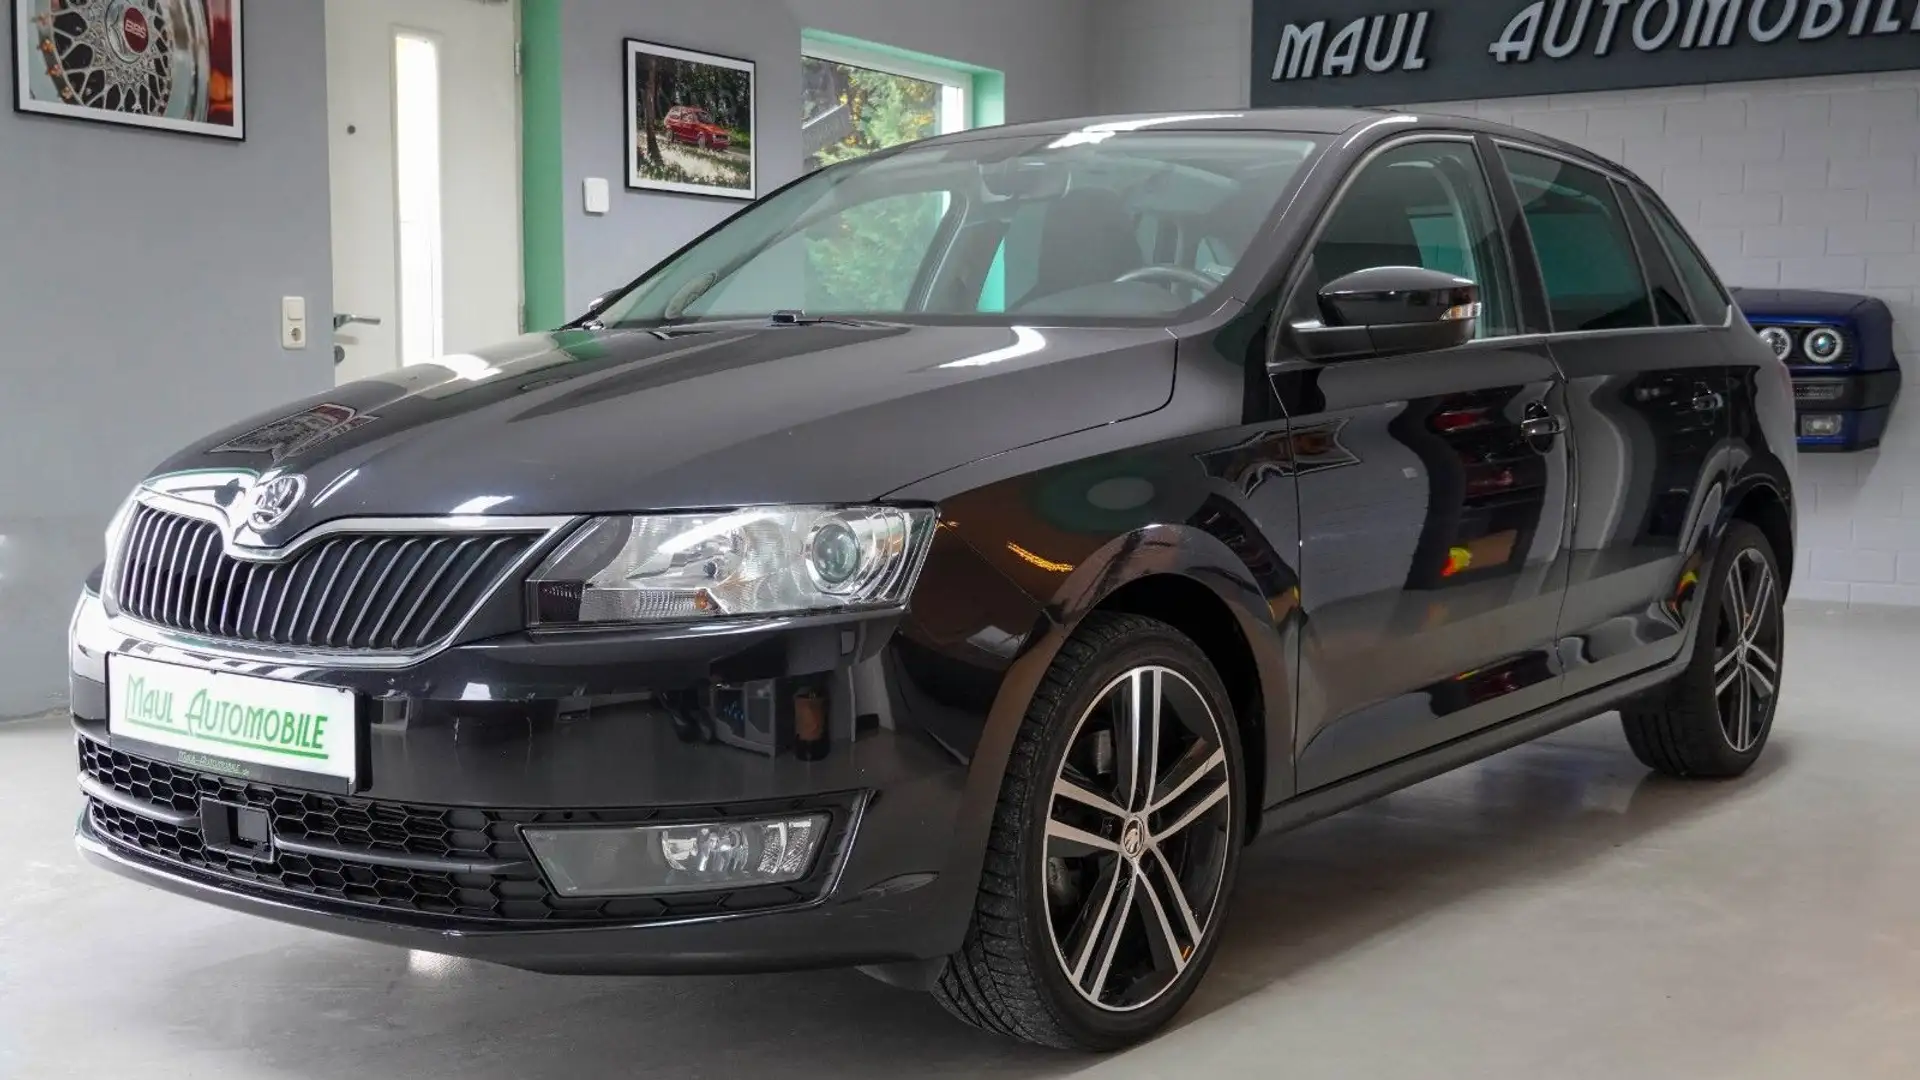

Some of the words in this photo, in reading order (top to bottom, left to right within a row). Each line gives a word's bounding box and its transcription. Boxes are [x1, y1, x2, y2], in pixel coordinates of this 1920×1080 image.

[125, 19, 147, 39] BBS
[1271, 11, 1430, 81] MAUL
[1488, 0, 1920, 63] AUTOMOBIL
[125, 674, 174, 723] MAUL
[184, 688, 328, 749] AUTOMOBILE
